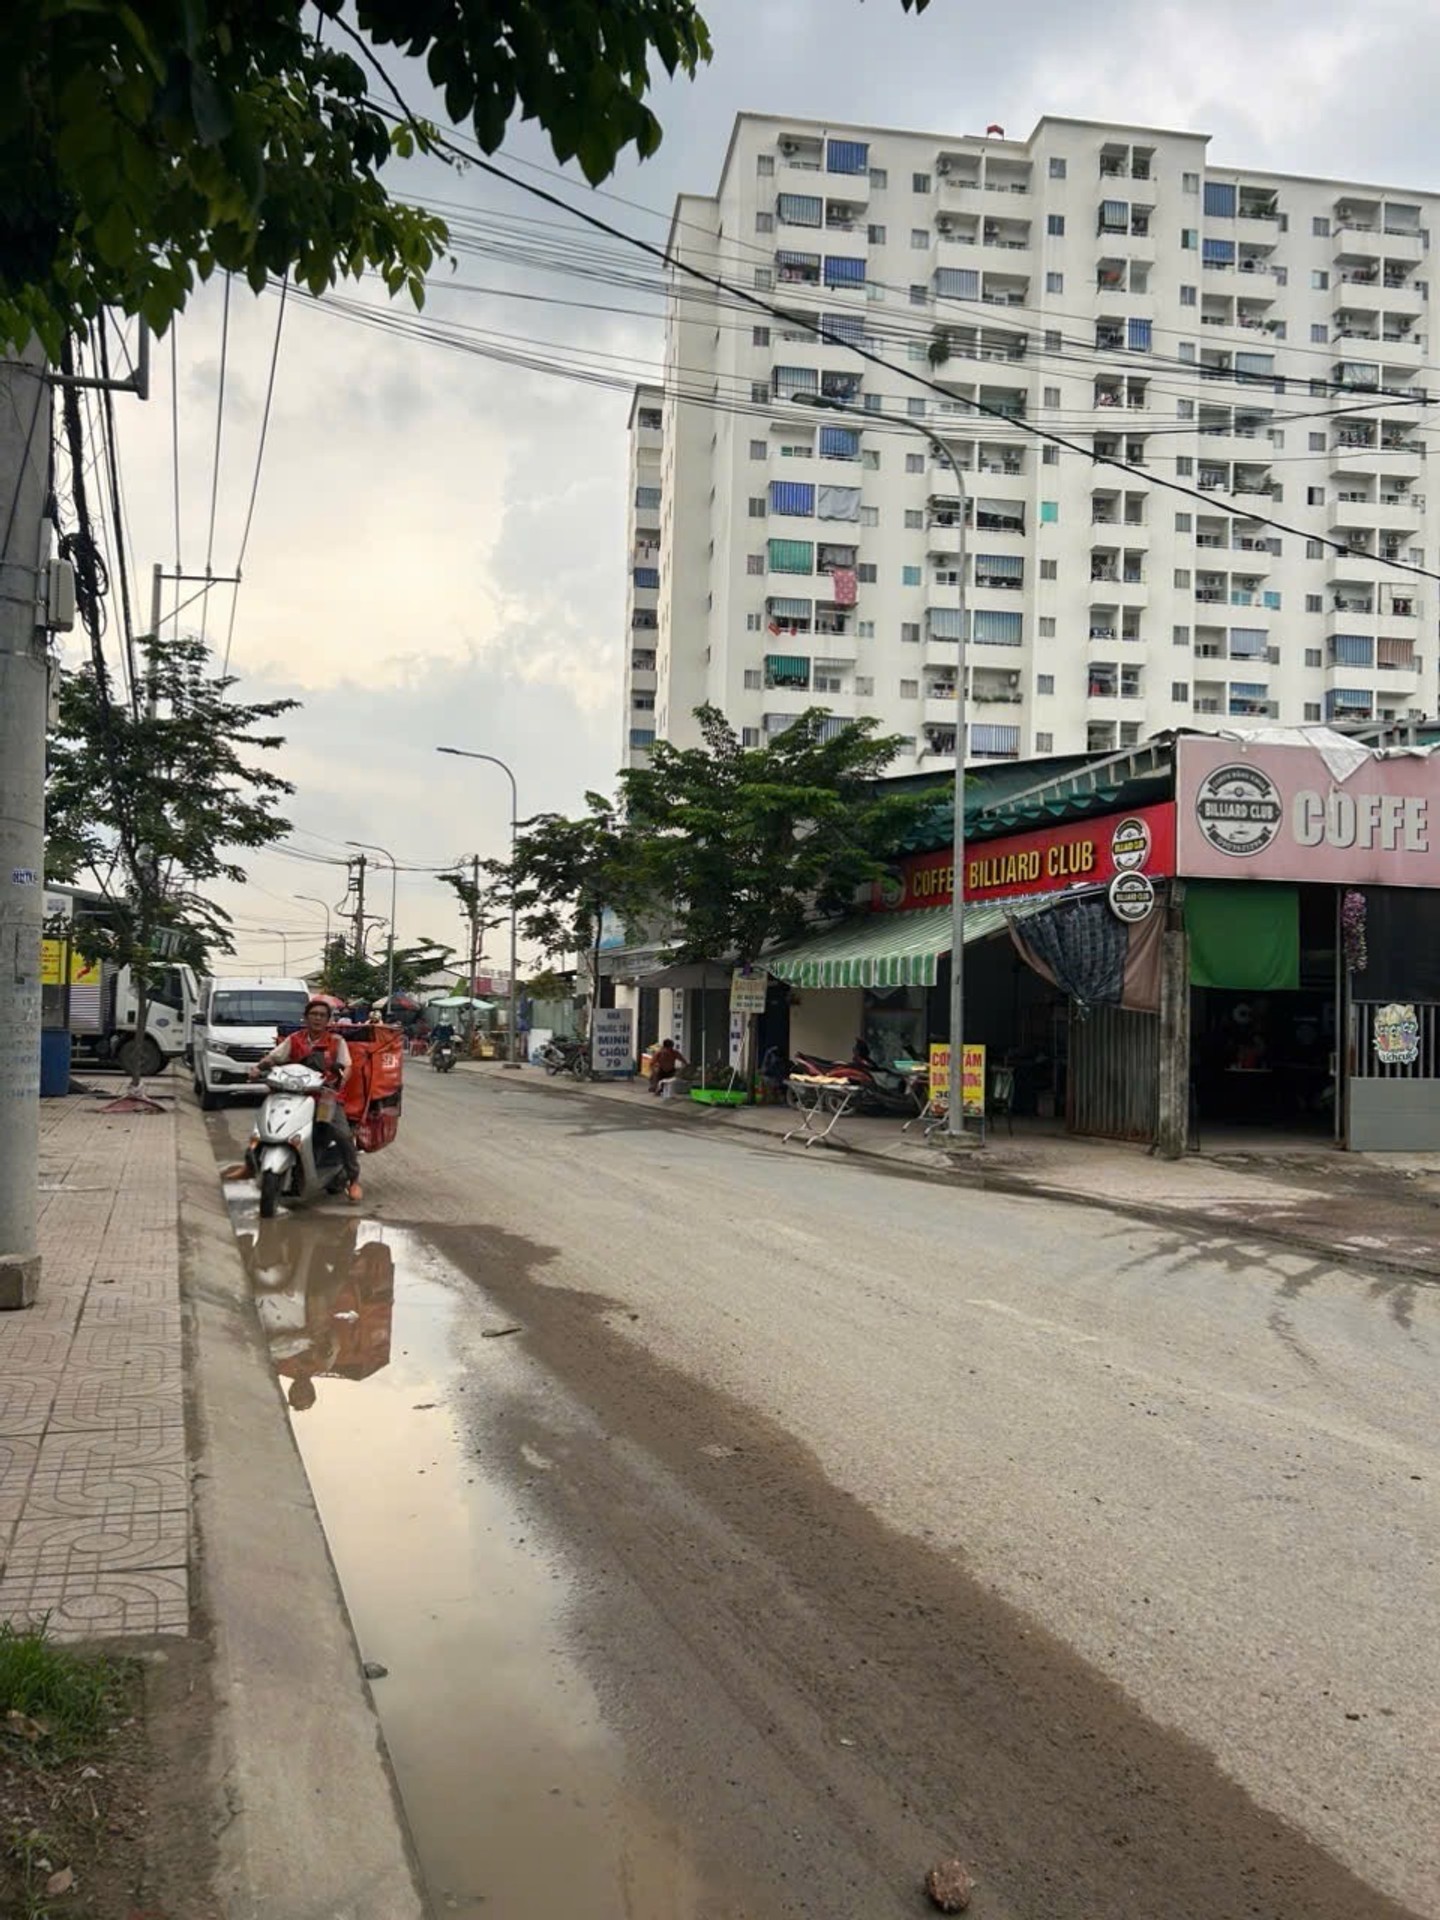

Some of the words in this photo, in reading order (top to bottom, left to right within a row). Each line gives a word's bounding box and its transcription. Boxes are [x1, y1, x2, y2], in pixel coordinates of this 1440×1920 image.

[1204, 802, 1248, 818] BILLIARD
[1249, 804, 1274, 819] CLUB
[1293, 790, 1429, 853] COFFE
[969, 850, 1040, 889] BILLIARD
[1049, 841, 1094, 877] CLUB
[598, 1035, 630, 1045] MINH
